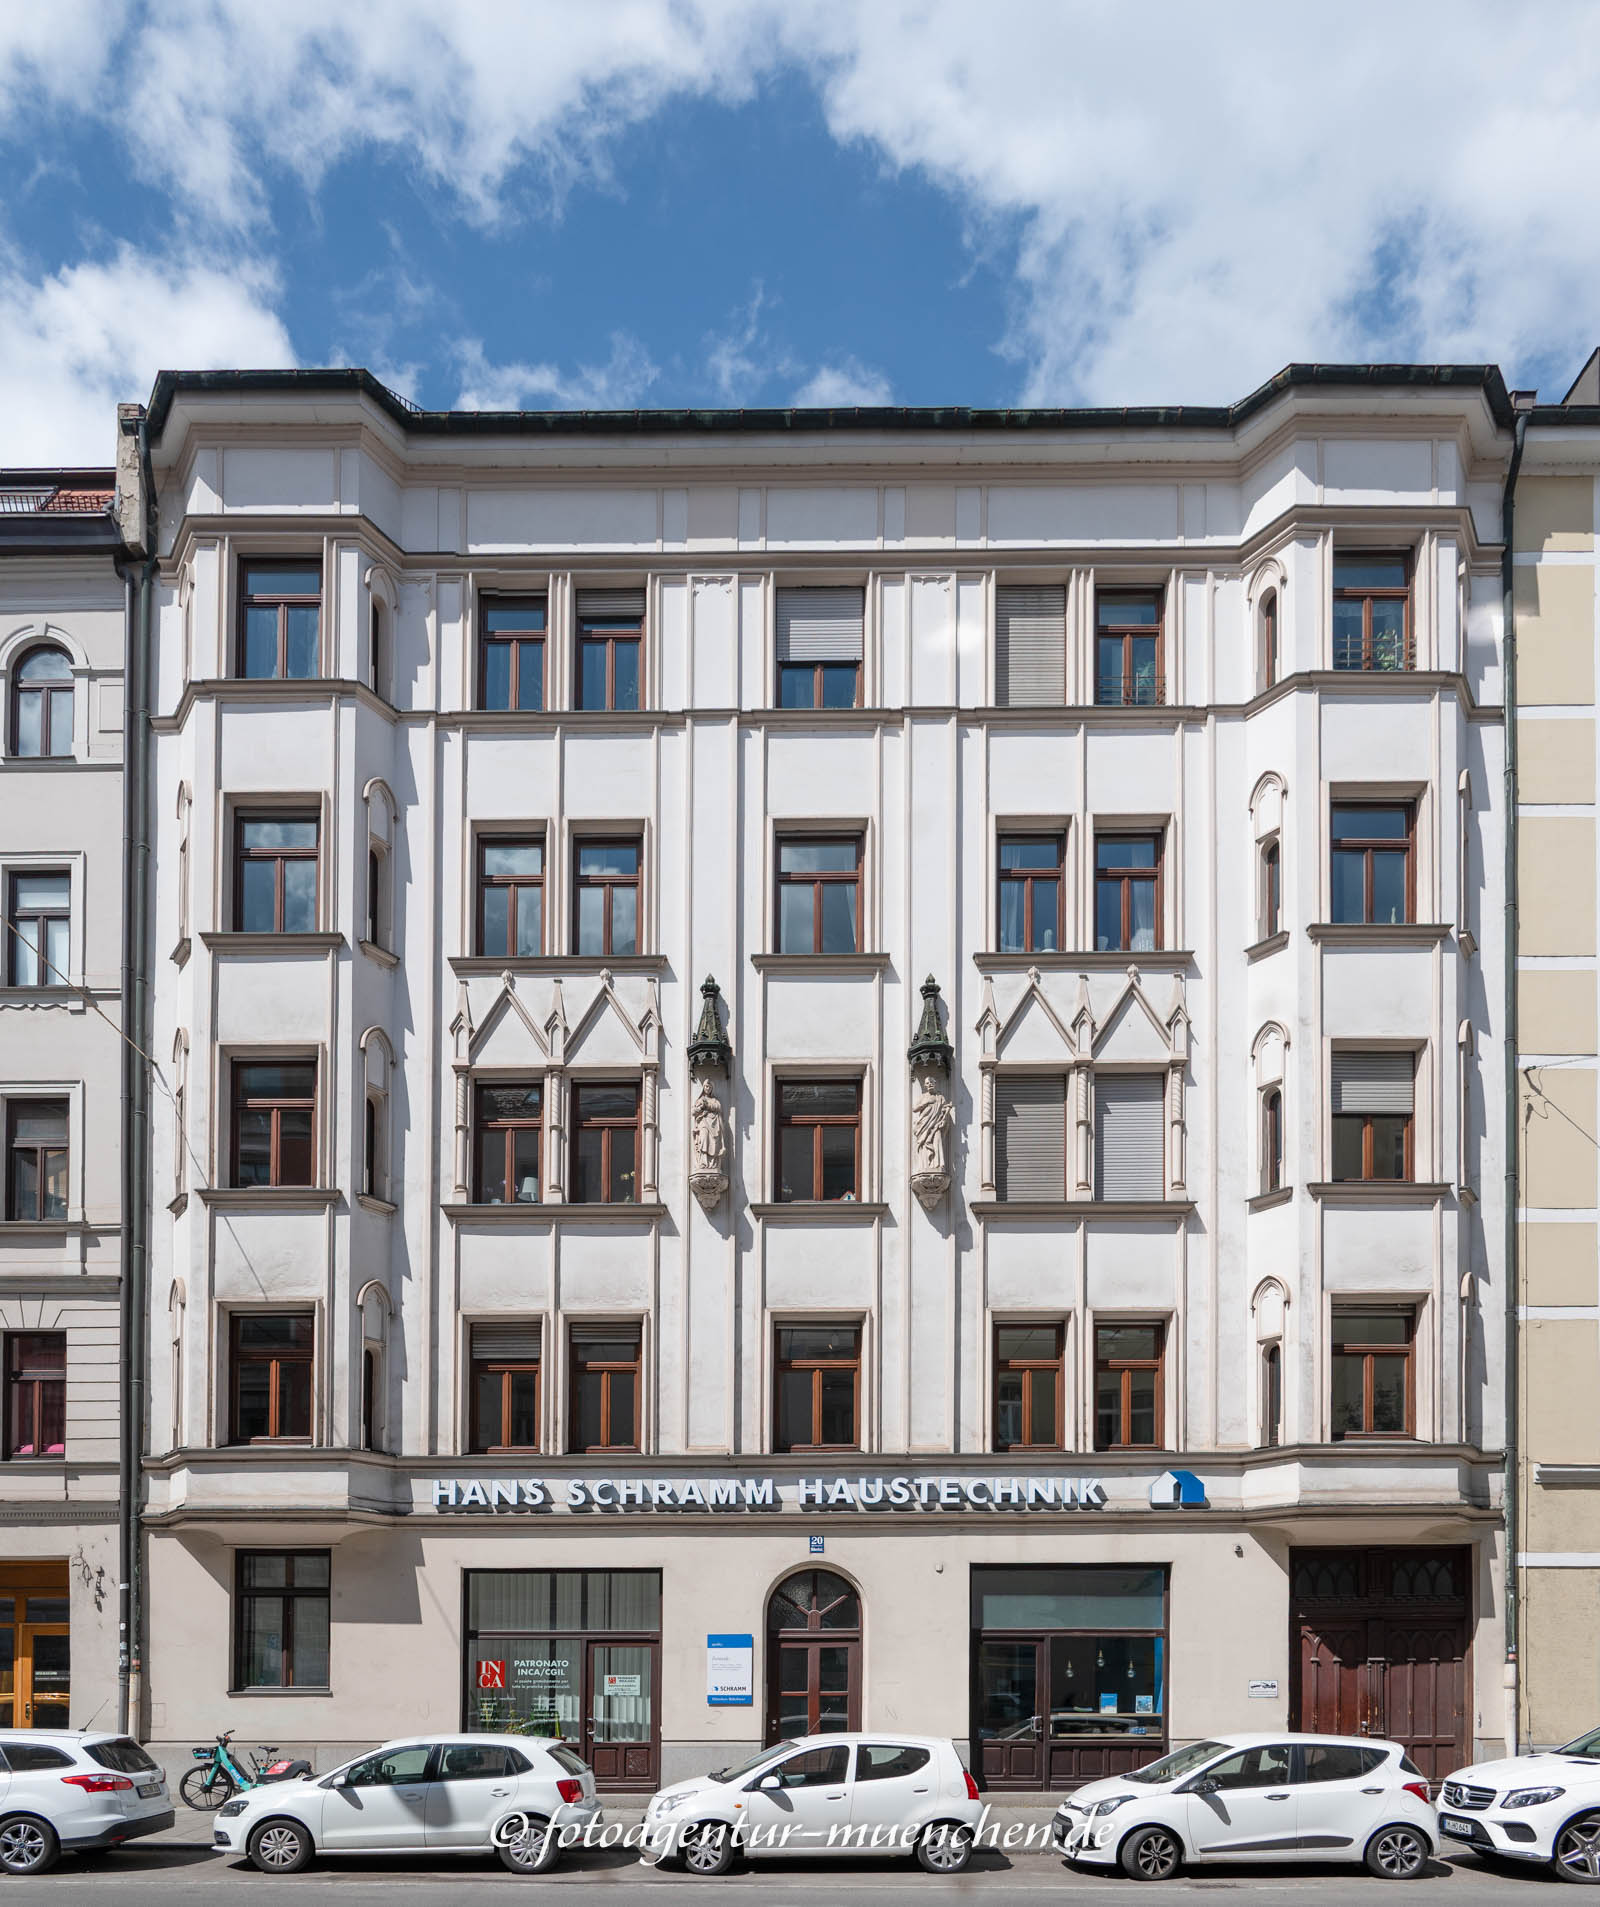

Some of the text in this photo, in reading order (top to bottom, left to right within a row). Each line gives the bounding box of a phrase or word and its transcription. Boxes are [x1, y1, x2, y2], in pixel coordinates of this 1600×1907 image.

[432, 1477, 1103, 1506] HANS SCHRAMM HAUSTECHNIK
[811, 1536, 823, 1545] 20
[481, 1660, 502, 1674] IN
[517, 1668, 566, 1677] INCA/CGIL
[479, 1674, 503, 1688] CA
